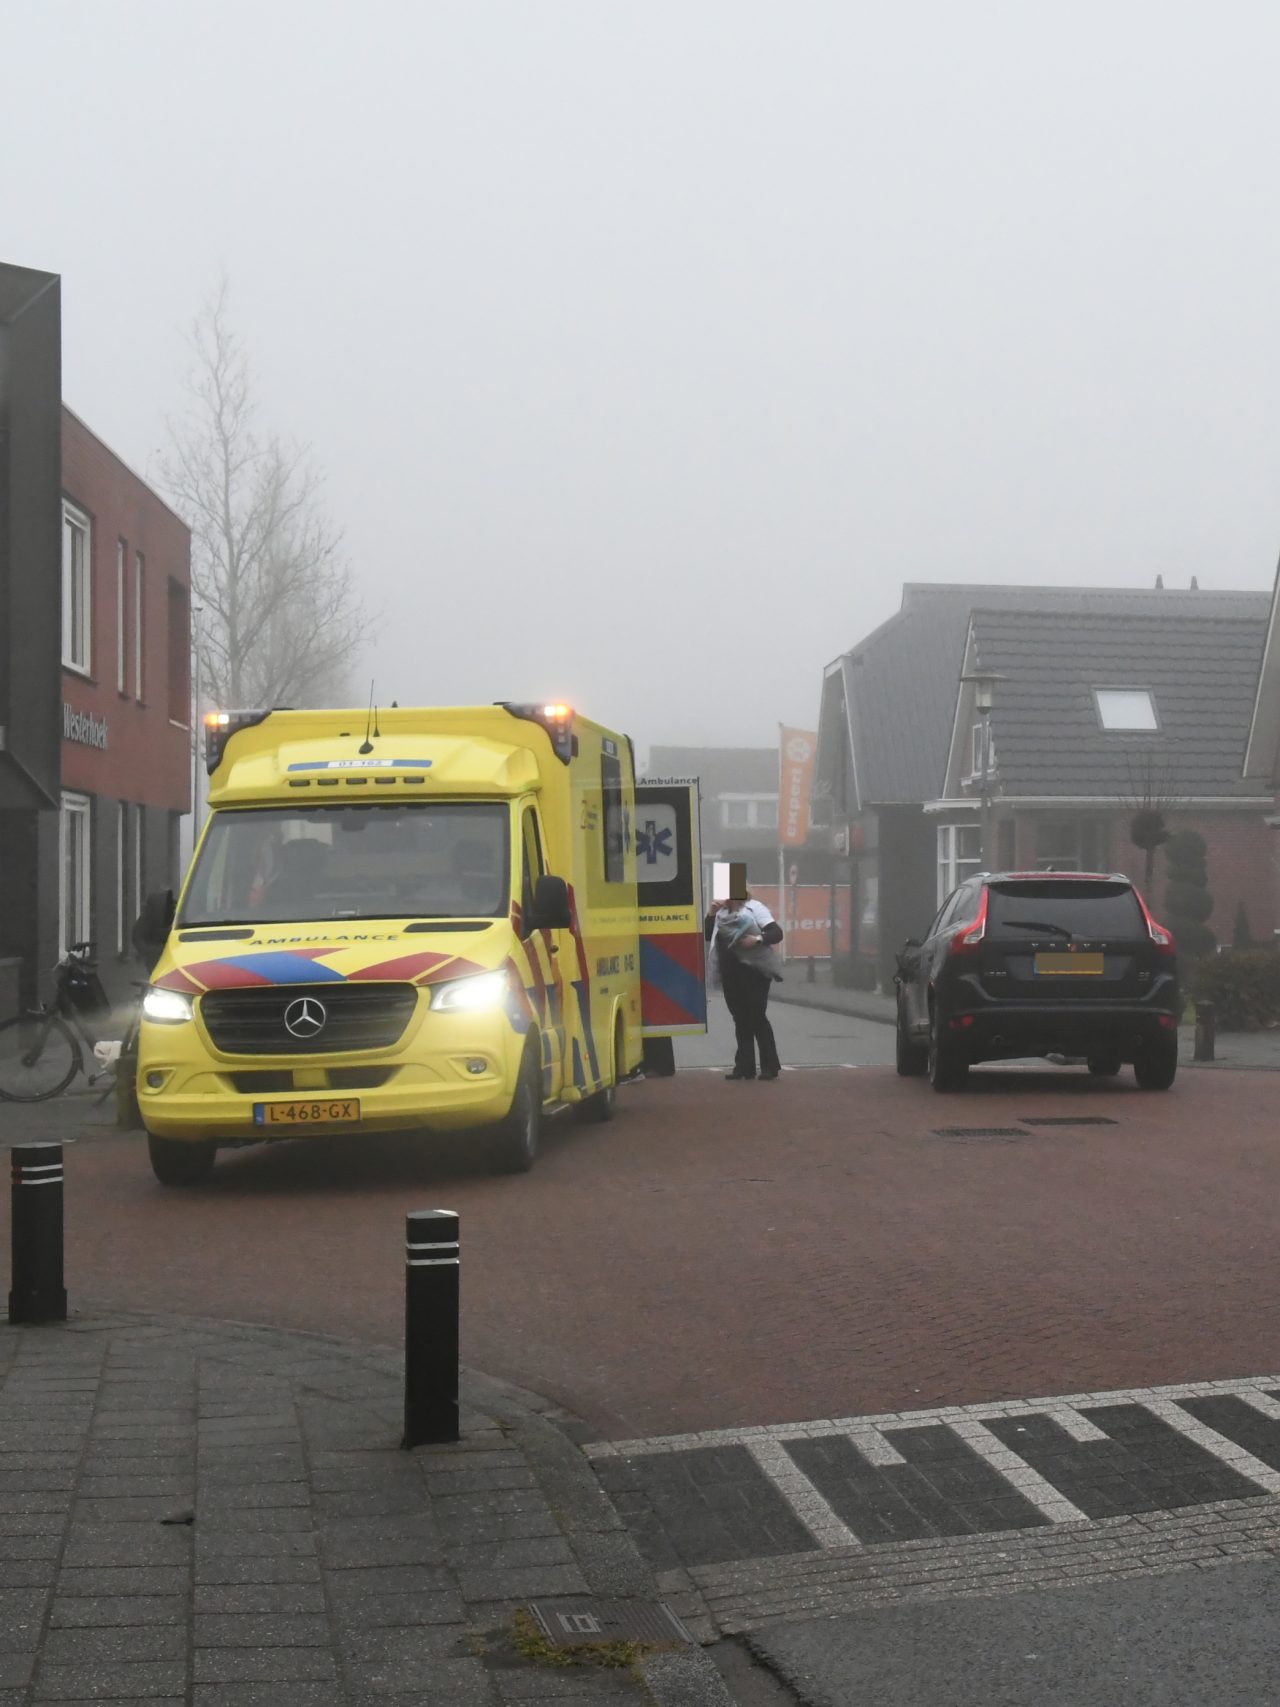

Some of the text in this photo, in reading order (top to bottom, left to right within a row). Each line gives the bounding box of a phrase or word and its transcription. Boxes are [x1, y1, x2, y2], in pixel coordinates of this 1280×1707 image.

[63, 702, 108, 750] Westerhoek
[640, 777, 698, 785] Ambulance
[787, 768, 802, 838] expert
[640, 913, 690, 922] MBULANCE
[250, 935, 400, 945] AMBULANCE
[270, 1103, 352, 1121] L-468-GX
